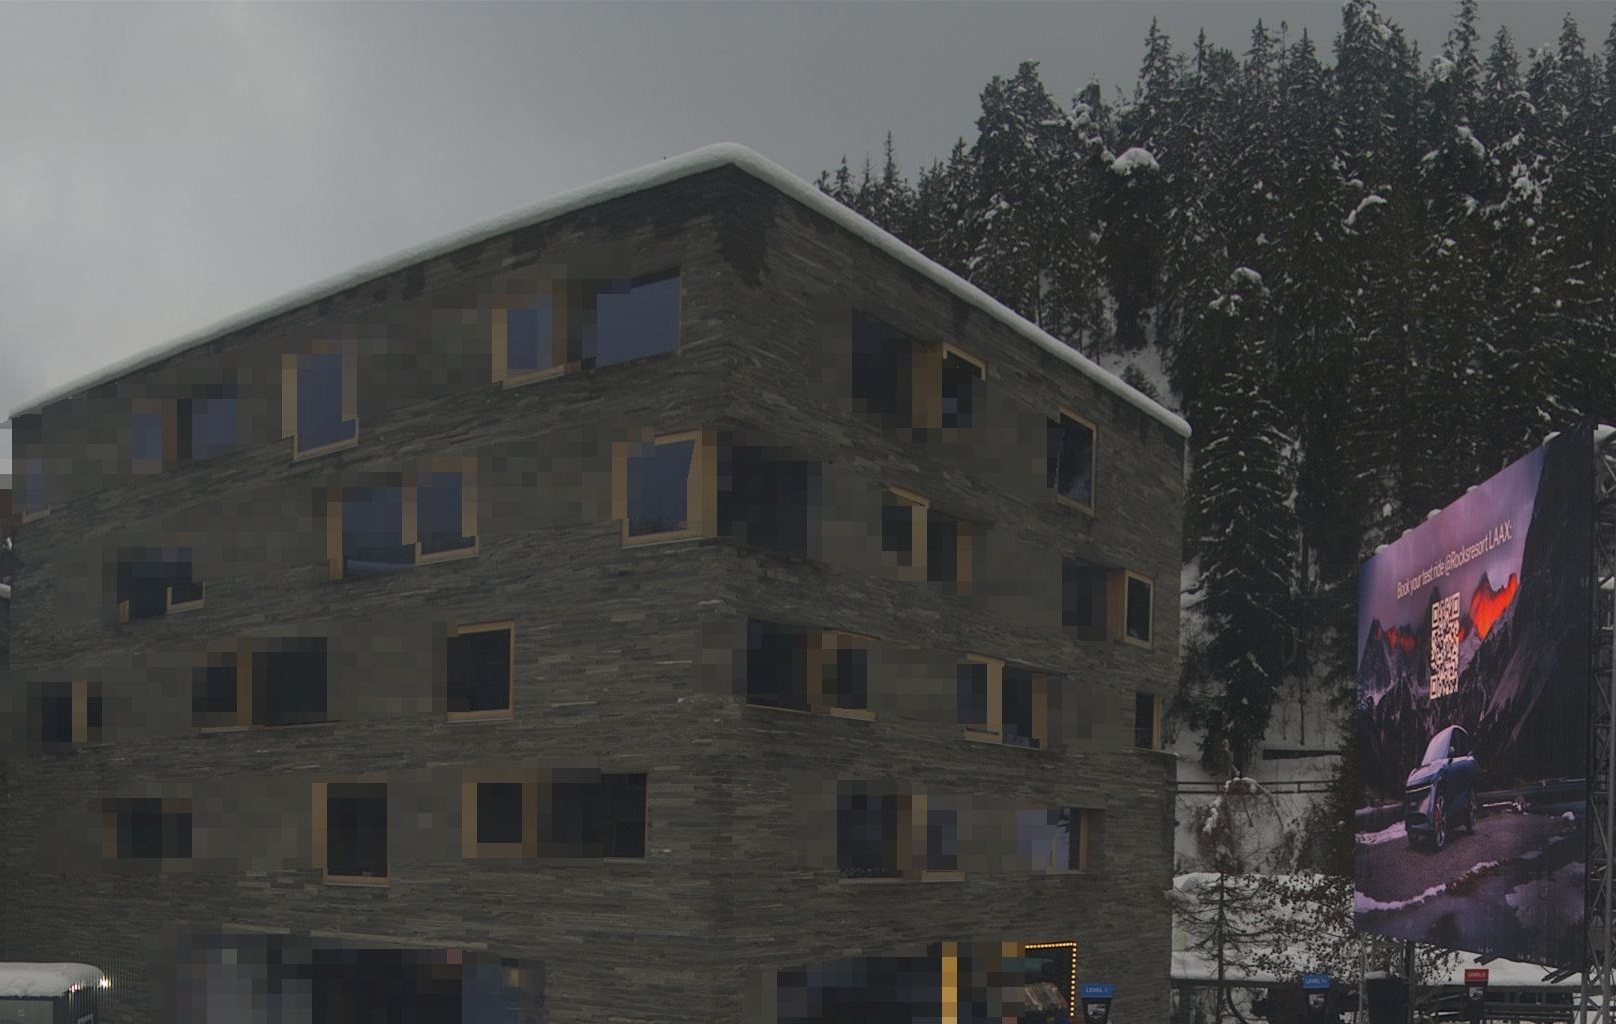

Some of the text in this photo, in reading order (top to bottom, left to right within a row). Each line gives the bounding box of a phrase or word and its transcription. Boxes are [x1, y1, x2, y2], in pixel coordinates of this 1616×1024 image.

[1397, 579, 1410, 599] Book
[1410, 574, 1422, 596] your
[1422, 565, 1433, 585] test
[1433, 559, 1445, 580] ride
